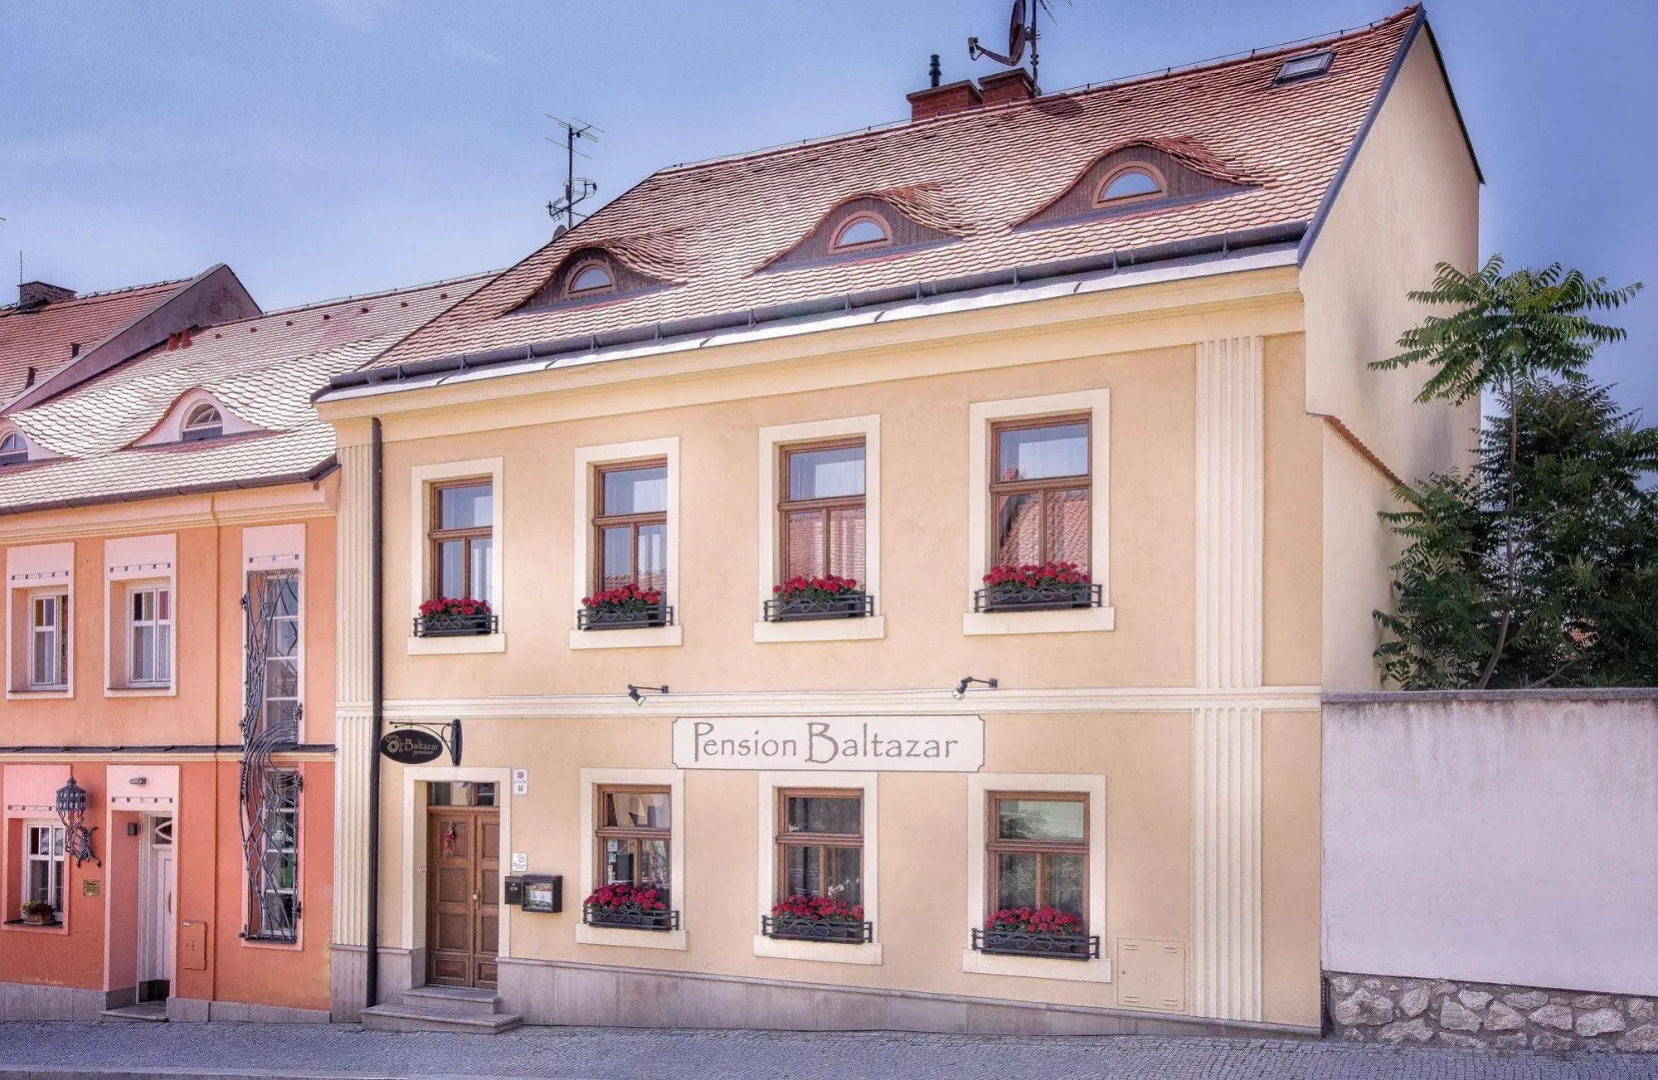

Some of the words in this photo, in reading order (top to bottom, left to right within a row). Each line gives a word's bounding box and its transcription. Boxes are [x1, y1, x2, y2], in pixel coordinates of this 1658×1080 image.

[404, 738, 439, 751] Baltazar
[693, 722, 797, 763] Pension
[804, 722, 958, 764] Baltazar
